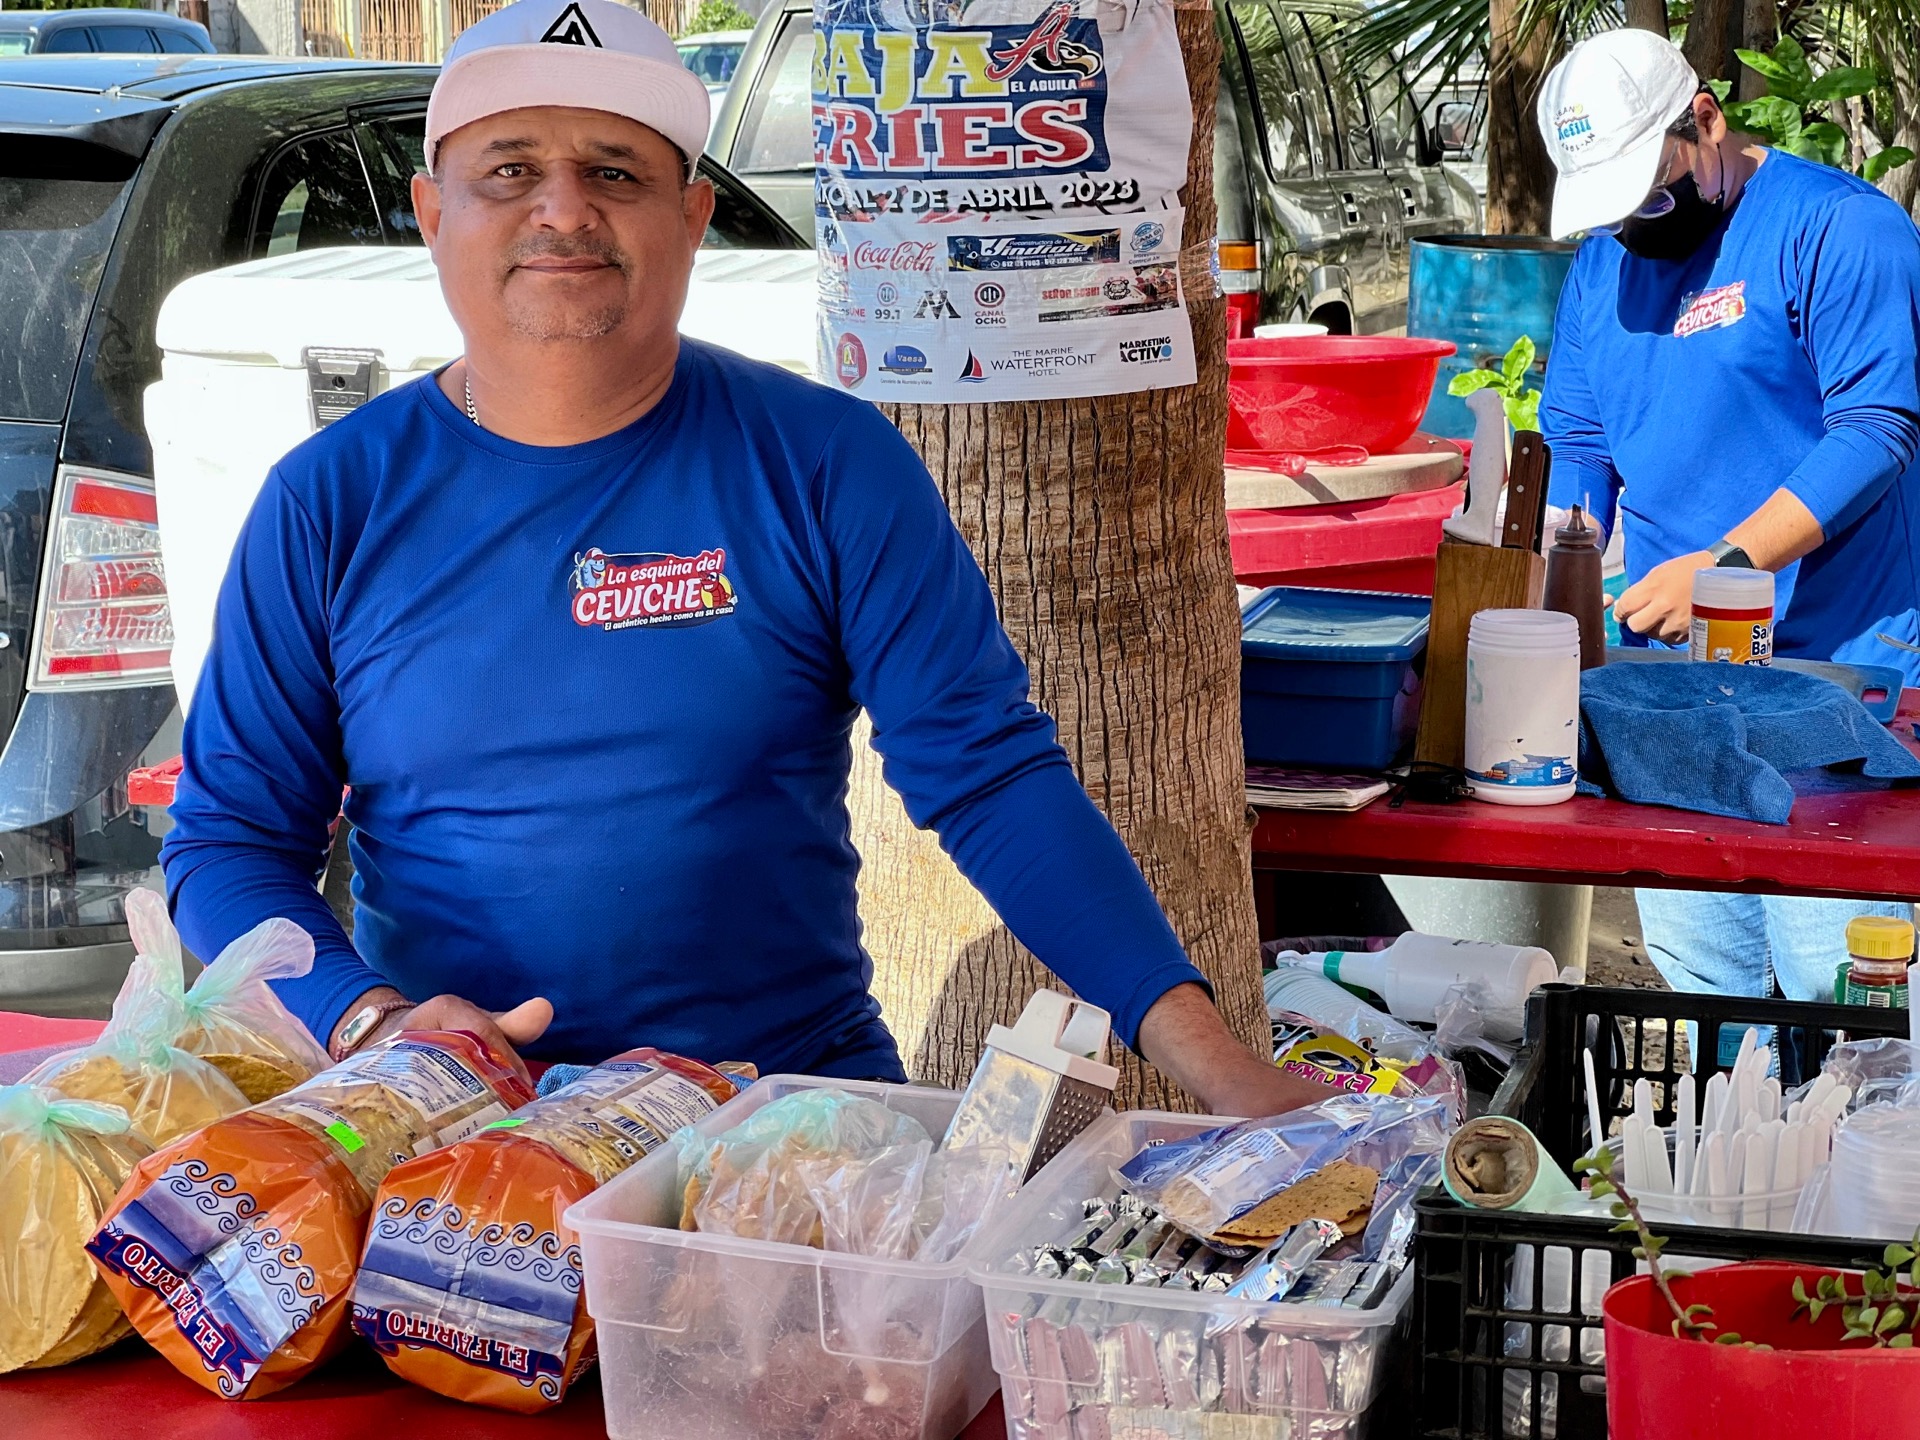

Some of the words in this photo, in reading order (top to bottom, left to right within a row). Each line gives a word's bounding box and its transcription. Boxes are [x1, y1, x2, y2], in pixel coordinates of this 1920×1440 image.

[1011, 81, 1026, 93] EL
[1029, 78, 1077, 92] ÁGUILA
[885, 186, 899, 208] 2
[908, 188, 945, 209] DE
[958, 182, 1046, 208] ABRIL
[1058, 178, 1134, 203] 2023
[854, 240, 938, 272] Coca-Cola
[1042, 289, 1072, 300] SEÑOR
[975, 317, 1006, 325] OCHO
[1674, 298, 1729, 335] CEVICHE
[1035, 347, 1074, 356] MARINE
[1120, 336, 1171, 350] MARKETING
[897, 354, 923, 363] Vaesa
[990, 353, 1097, 370] WATERFRONT
[1028, 369, 1061, 377] HOTEL
[607, 568, 626, 585] La
[630, 560, 692, 583] esquina
[696, 555, 722, 572] del
[576, 578, 702, 622] CEVICHE
[604, 622, 612, 631] El
[649, 614, 672, 624] hecho
[673, 612, 693, 621] como
[705, 609, 714, 617] su
[715, 606, 734, 615] casa
[122, 1242, 199, 1329] FARITO
[193, 1315, 226, 1360] EL
[386, 1309, 491, 1362] FARITO
[497, 1341, 530, 1373] EL
